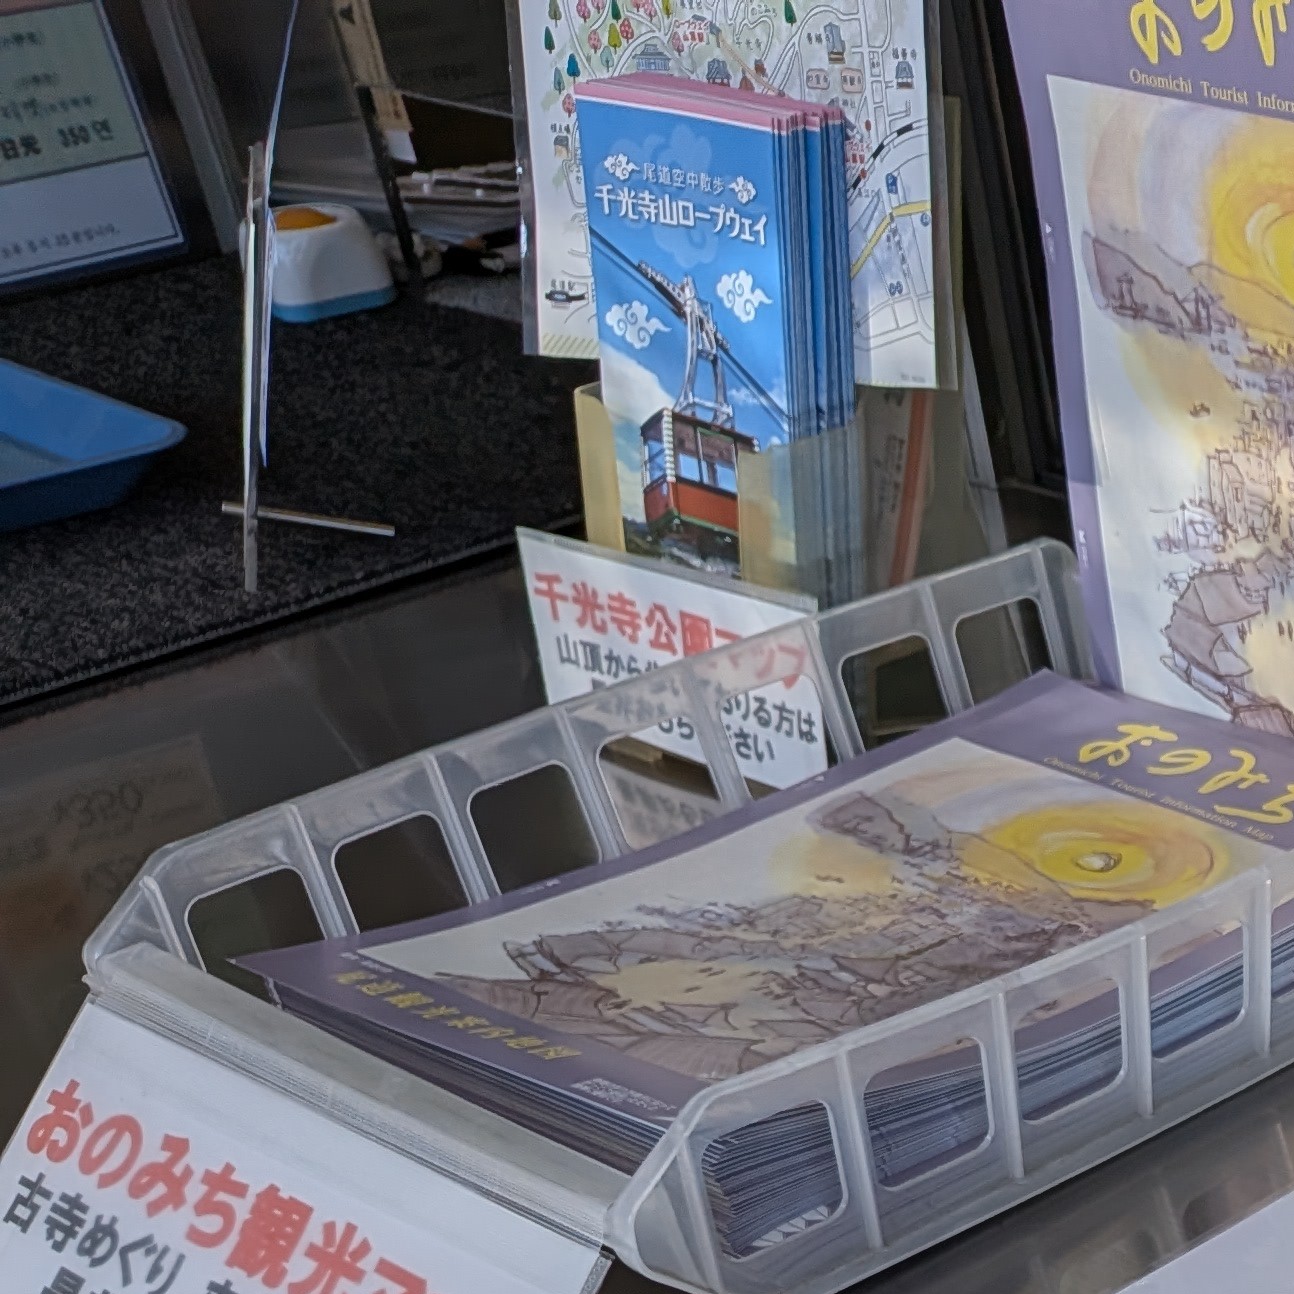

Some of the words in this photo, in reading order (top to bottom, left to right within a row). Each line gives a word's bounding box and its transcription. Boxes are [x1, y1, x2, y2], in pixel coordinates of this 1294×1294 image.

[1130, 68, 1192, 95] Onomichi
[1201, 79, 1248, 106] Tourist
[642, 162, 725, 194] 尾道空中散歩
[594, 184, 767, 247] 千光寺山ロープウェイ
